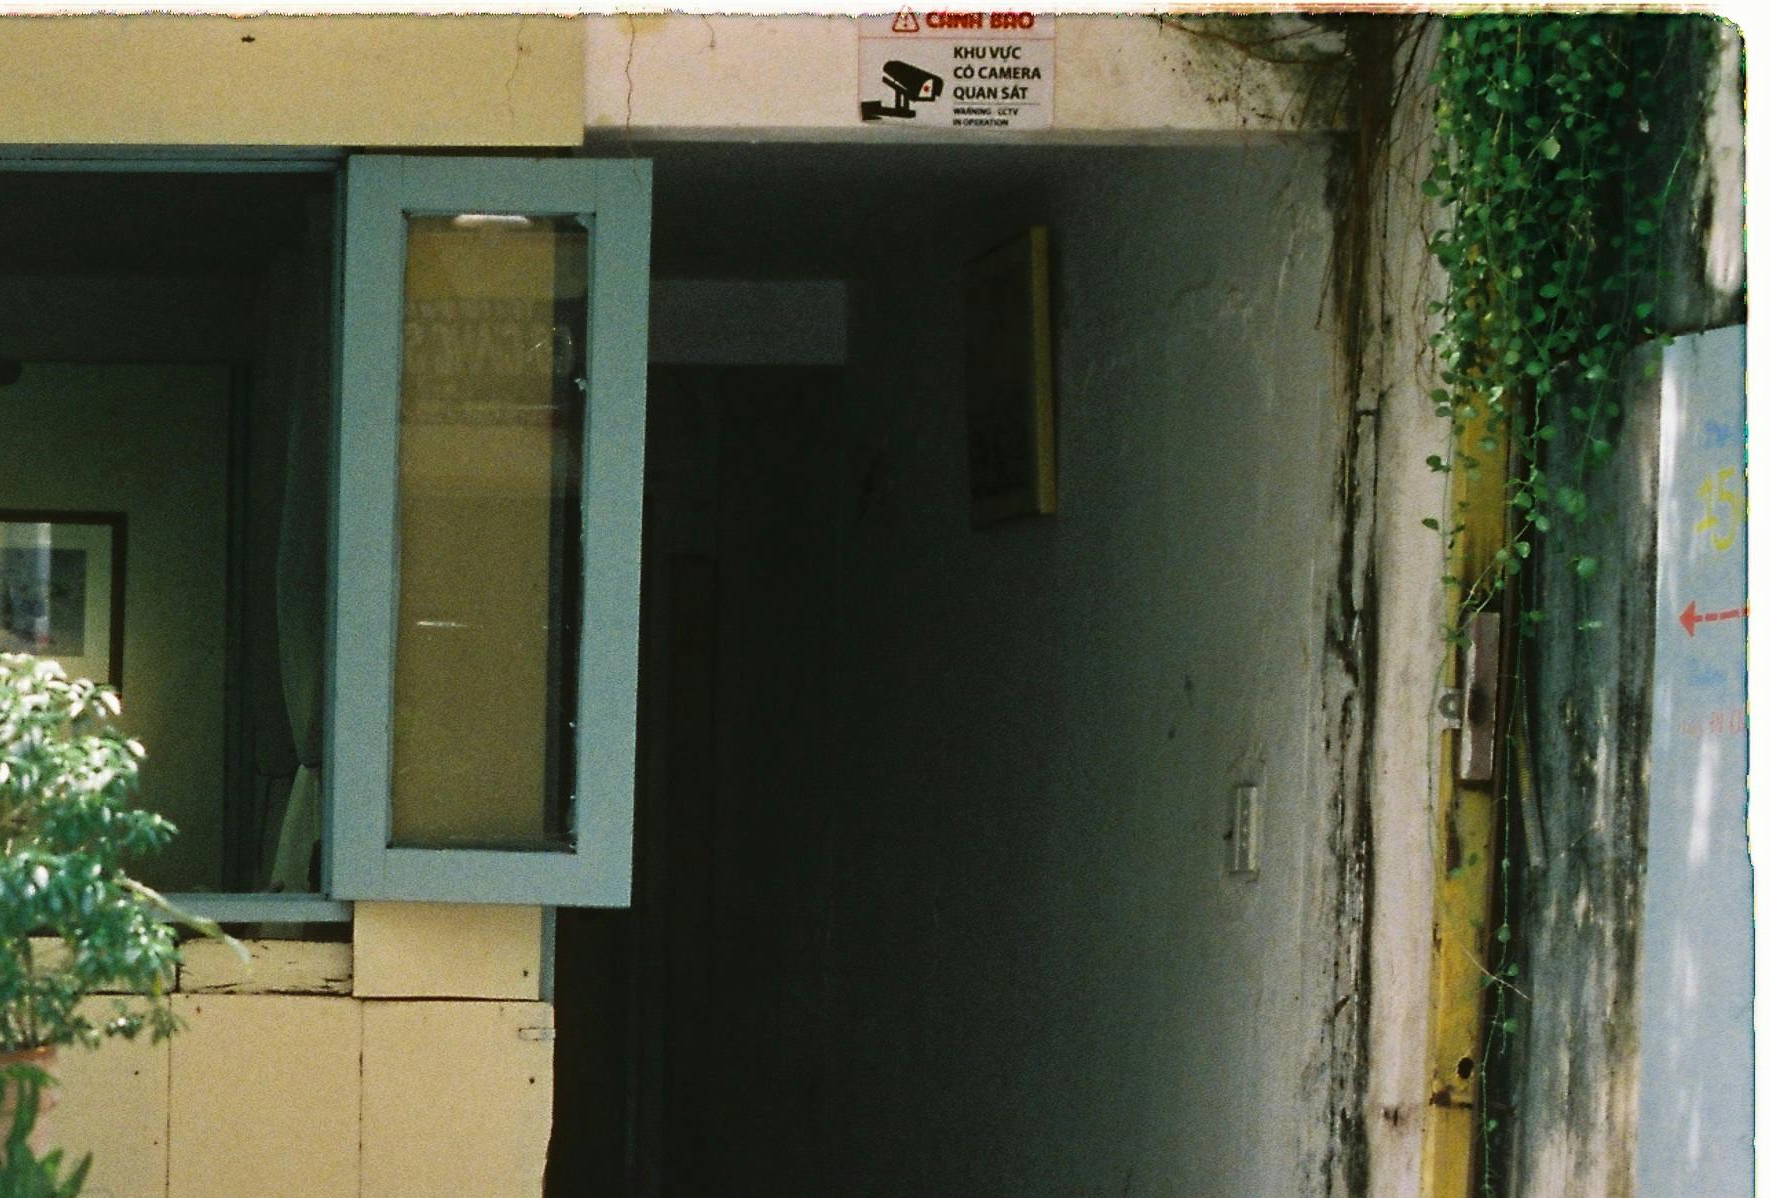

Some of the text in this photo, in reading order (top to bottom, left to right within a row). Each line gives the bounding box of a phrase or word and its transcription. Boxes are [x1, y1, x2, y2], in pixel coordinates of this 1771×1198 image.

[953, 46, 986, 59] KHU
[978, 66, 1042, 79] CAMERA
[953, 84, 1029, 101] QUAN SÁT
